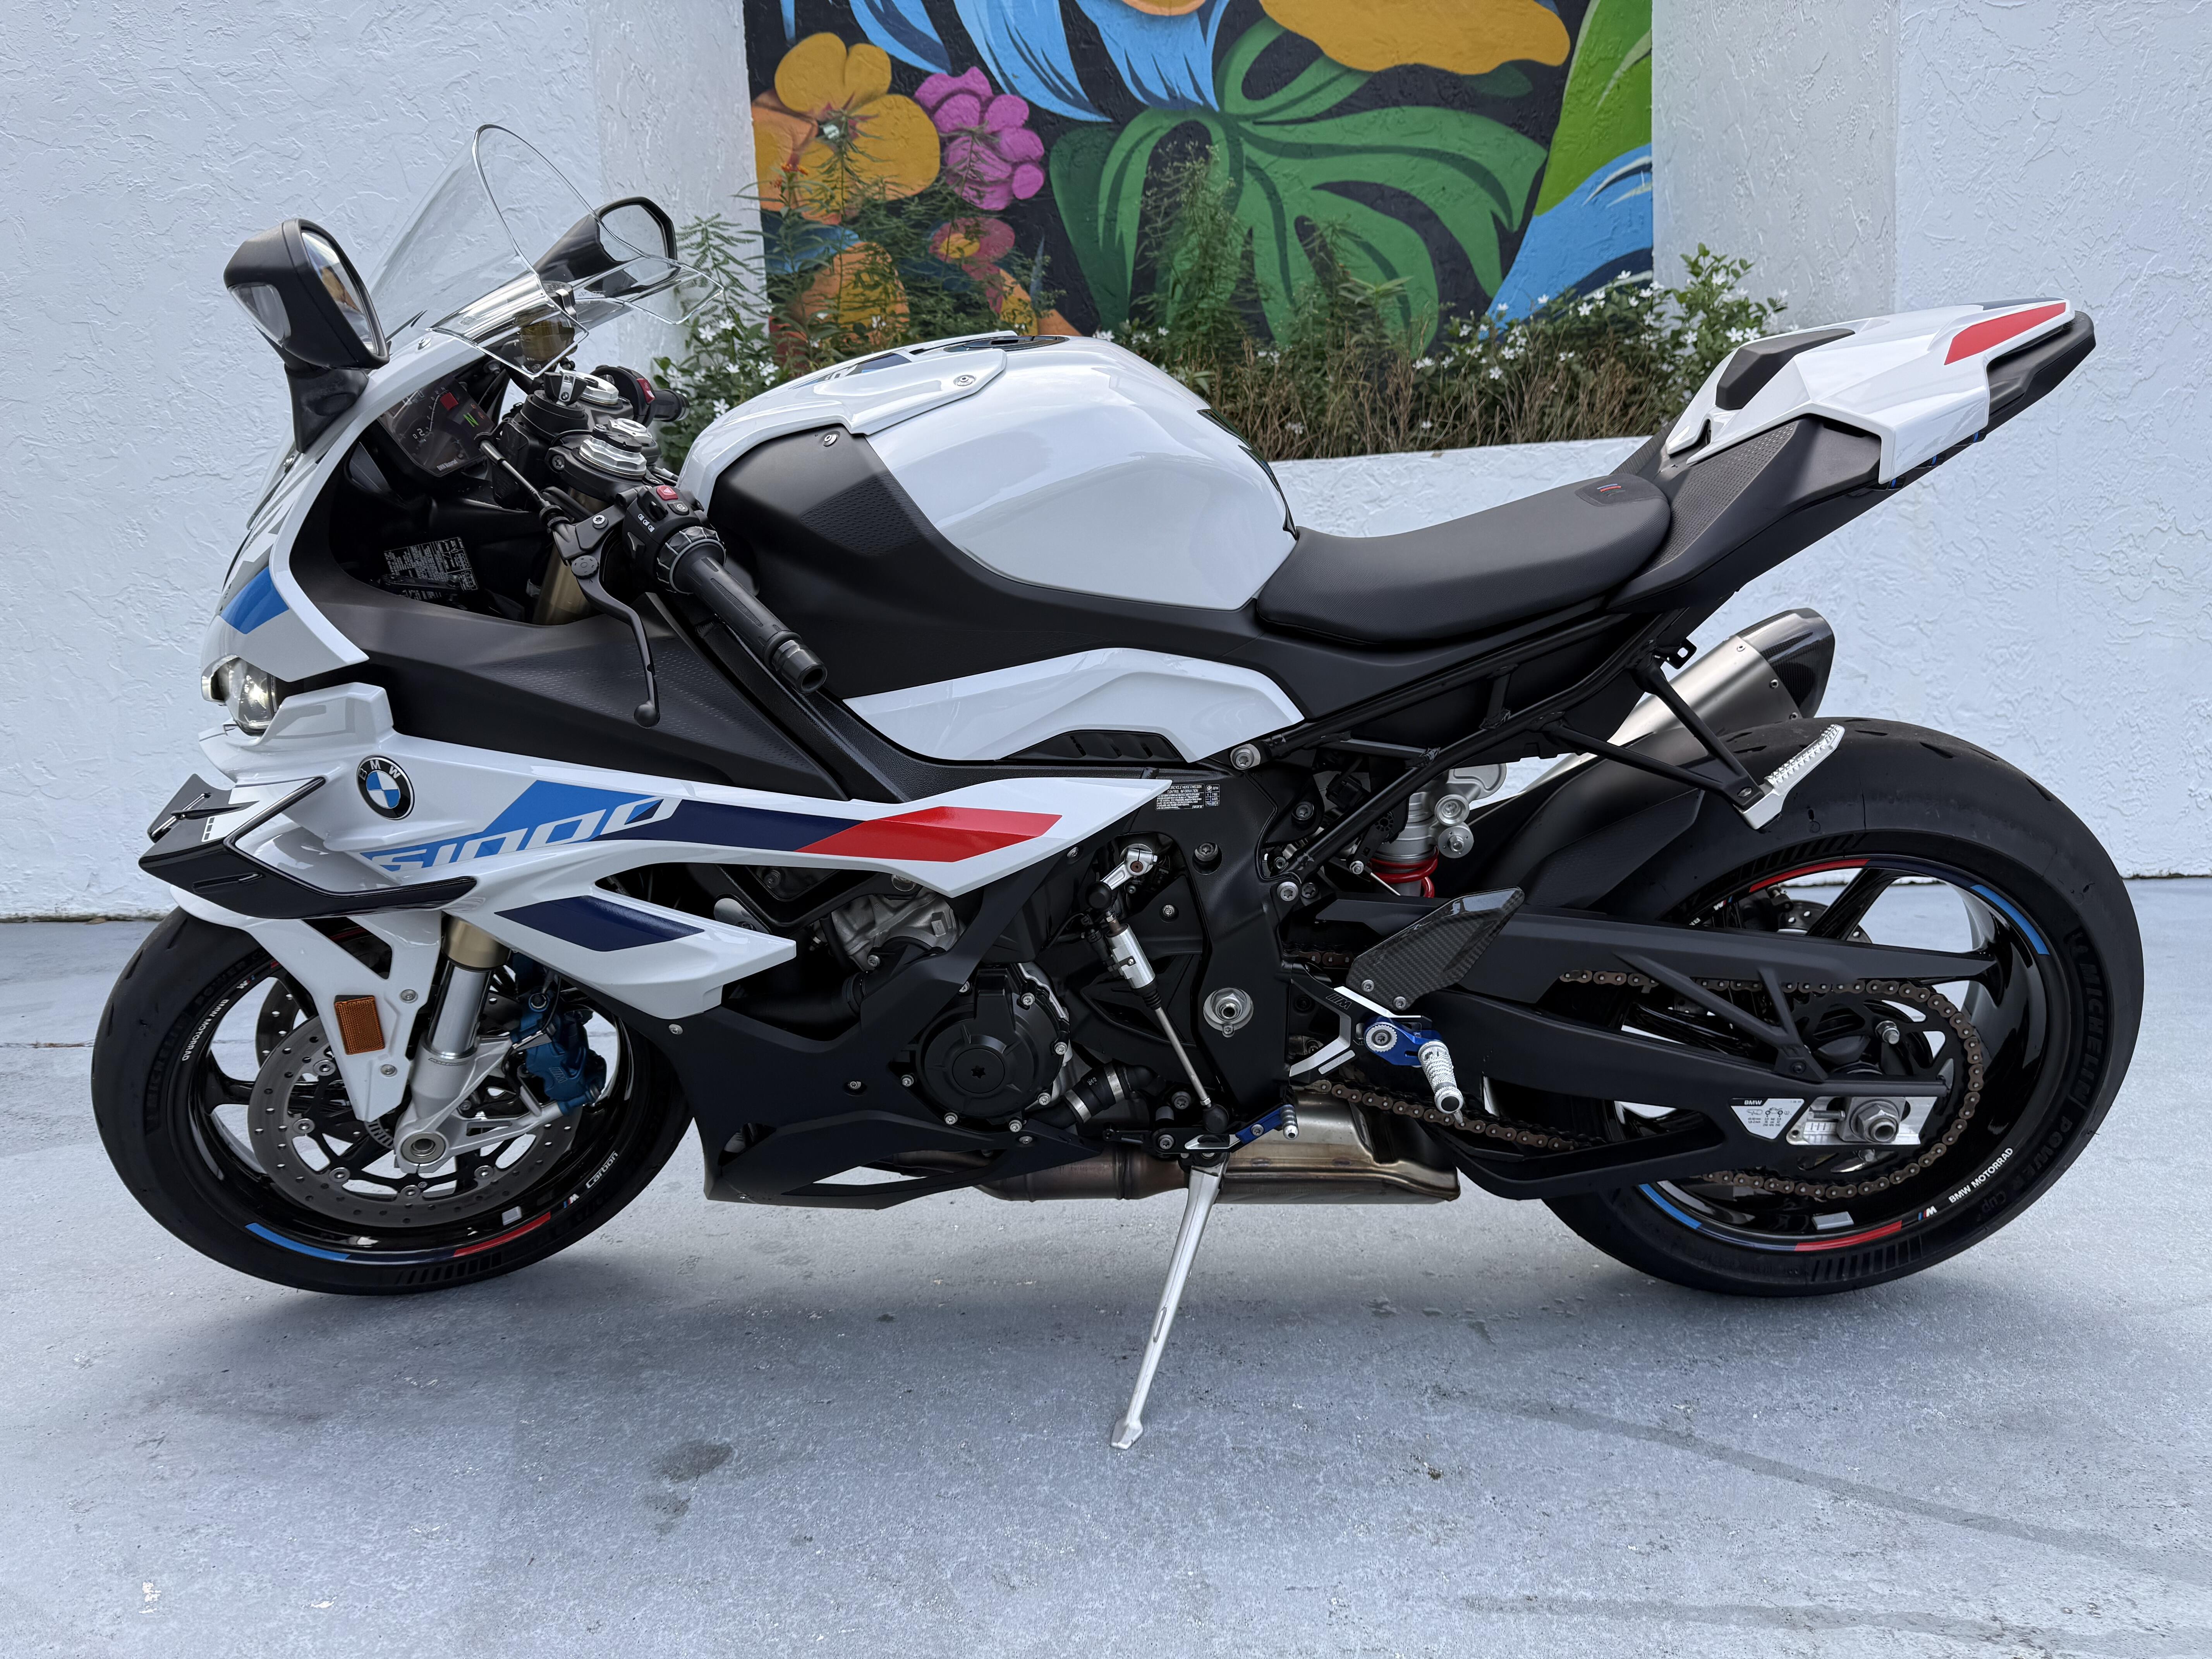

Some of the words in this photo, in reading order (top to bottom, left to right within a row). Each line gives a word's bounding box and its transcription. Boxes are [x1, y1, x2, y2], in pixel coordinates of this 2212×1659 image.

[463, 413, 479, 428] N
[358, 759, 401, 780] BMW
[210, 999, 230, 1017] BMW
[182, 1018, 212, 1061] MOTORRAD
[585, 1150, 619, 1189] Carbon
[1949, 1185, 1972, 1203] BMW
[1971, 1147, 2013, 1188] MOTORRAD
